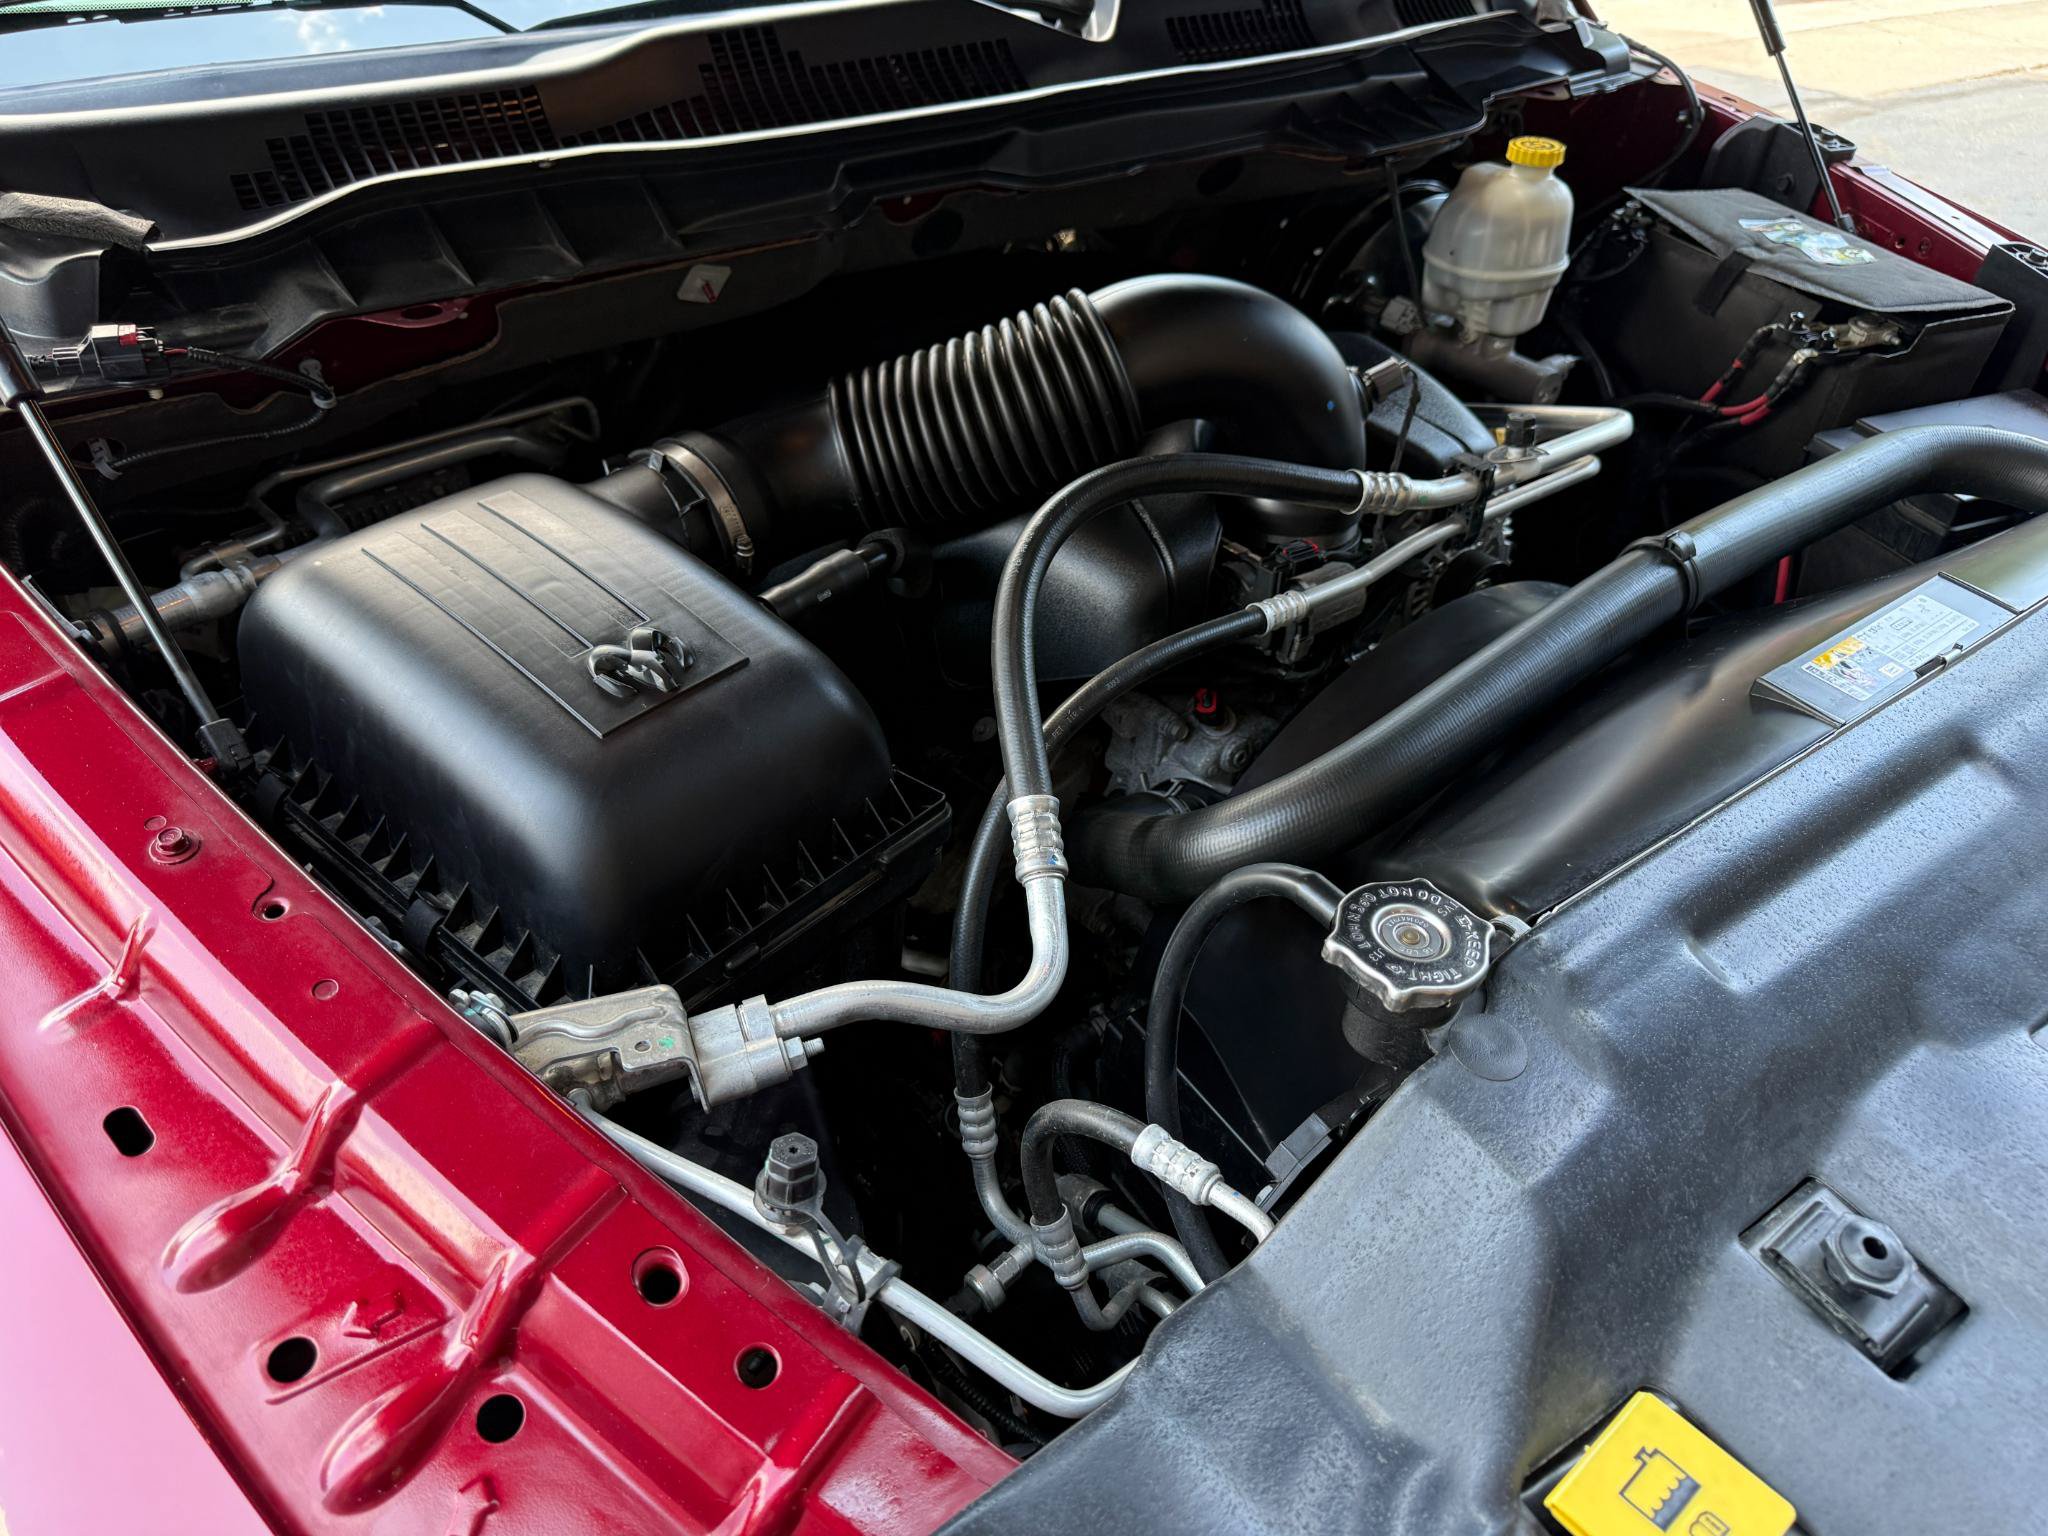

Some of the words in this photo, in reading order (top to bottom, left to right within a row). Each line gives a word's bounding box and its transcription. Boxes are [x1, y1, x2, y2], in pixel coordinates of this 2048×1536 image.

[1380, 886, 1413, 899] NOT
[1418, 890, 1441, 905] DO
[1349, 923, 1371, 949] HOT
[1465, 931, 1481, 968] KEEP
[1408, 967, 1462, 982] TIGHT
